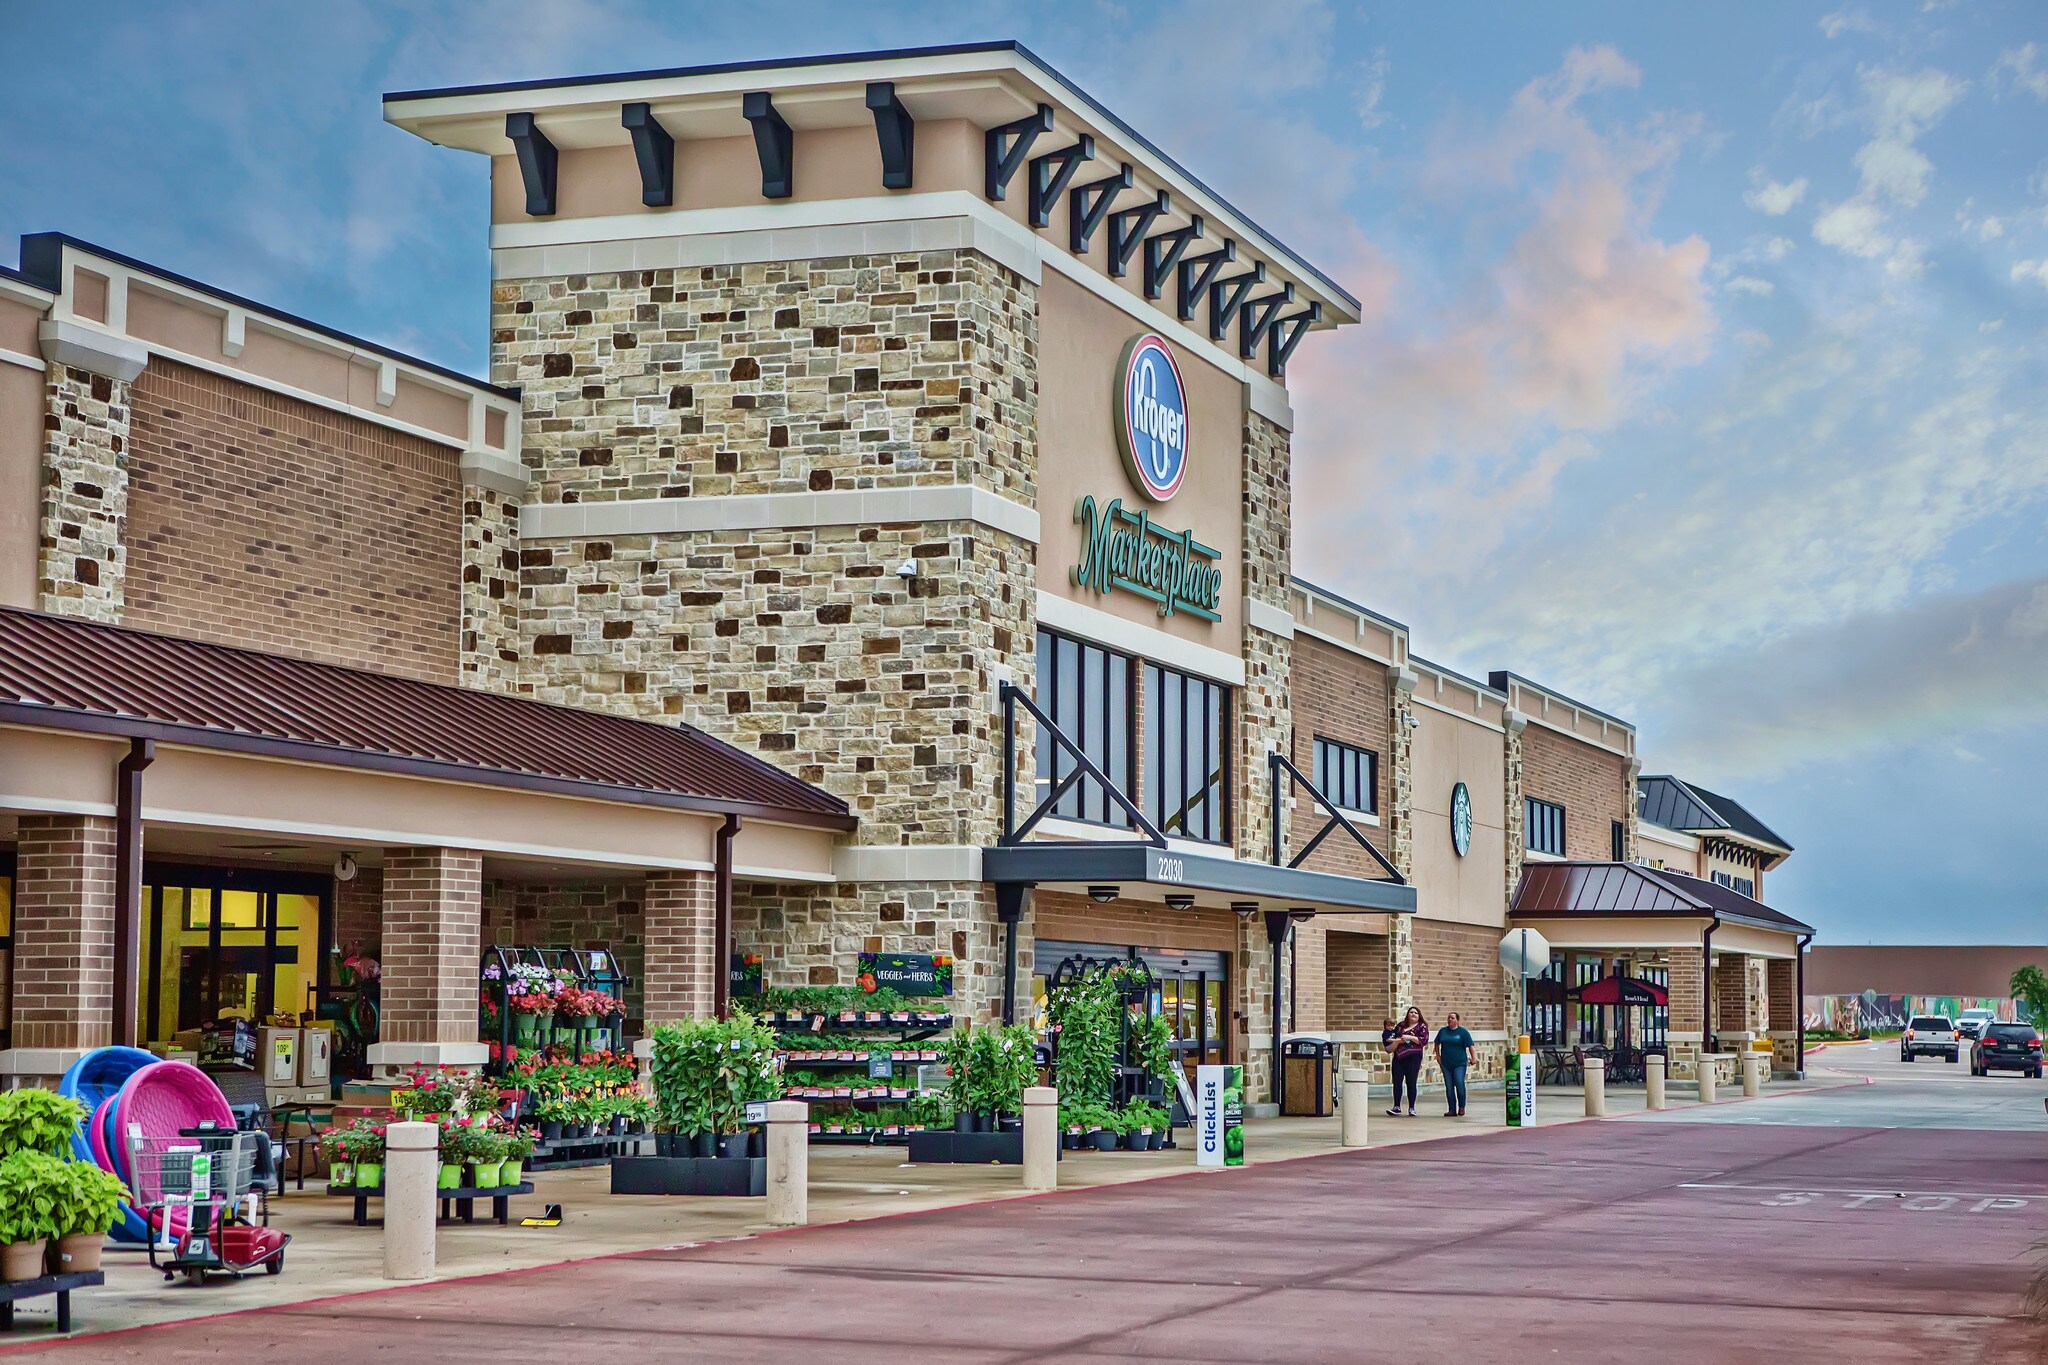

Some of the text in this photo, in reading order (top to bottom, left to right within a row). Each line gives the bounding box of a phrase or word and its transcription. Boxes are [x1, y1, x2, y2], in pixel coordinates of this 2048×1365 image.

[1132, 357, 1184, 481] Kroger
[1076, 494, 1222, 617] Marketplace
[1158, 857, 1183, 881] 22030
[731, 971, 744, 981] RBS
[877, 970, 903, 981] VEGGIES
[911, 971, 933, 982] HERBS
[1524, 1065, 1532, 1117] ClickList
[1204, 1081, 1216, 1153] ClickList
[1759, 1191, 2030, 1213] STOP
